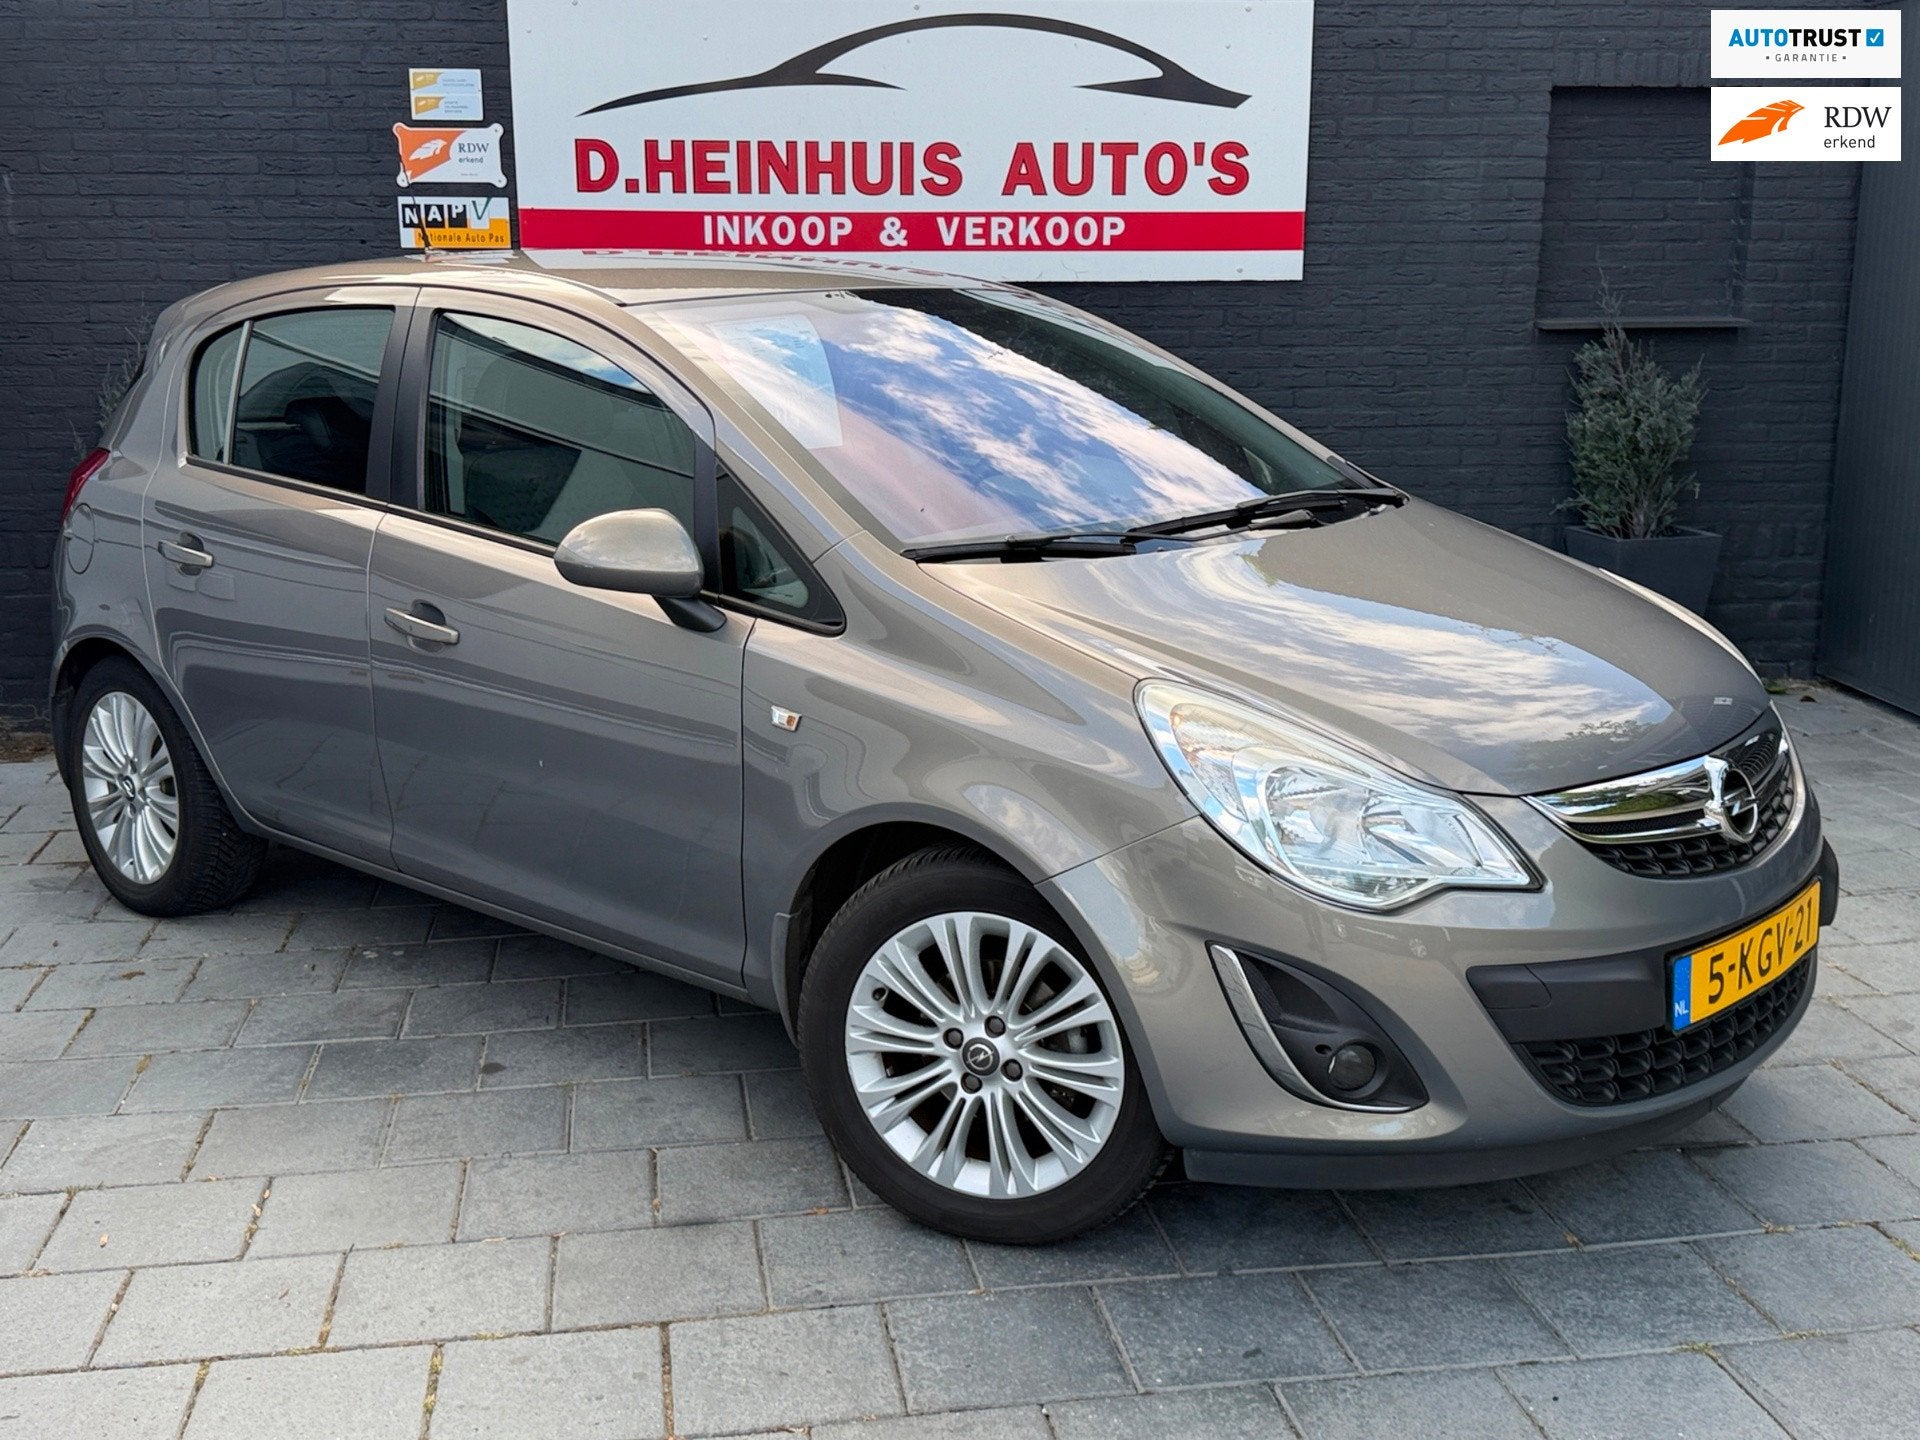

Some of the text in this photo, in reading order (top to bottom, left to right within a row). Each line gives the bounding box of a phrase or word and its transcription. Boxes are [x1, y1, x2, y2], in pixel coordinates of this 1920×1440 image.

[458, 143, 489, 153] RDW
[575, 138, 1250, 196] D.HEINHUIS AUTO'S
[418, 232, 504, 243] Ntionale Auto Pas
[703, 214, 1126, 247] INKOOP & VERKOOP
[1708, 897, 1813, 1005] 5-KGV-21
[1674, 1000, 1689, 1018] NL
